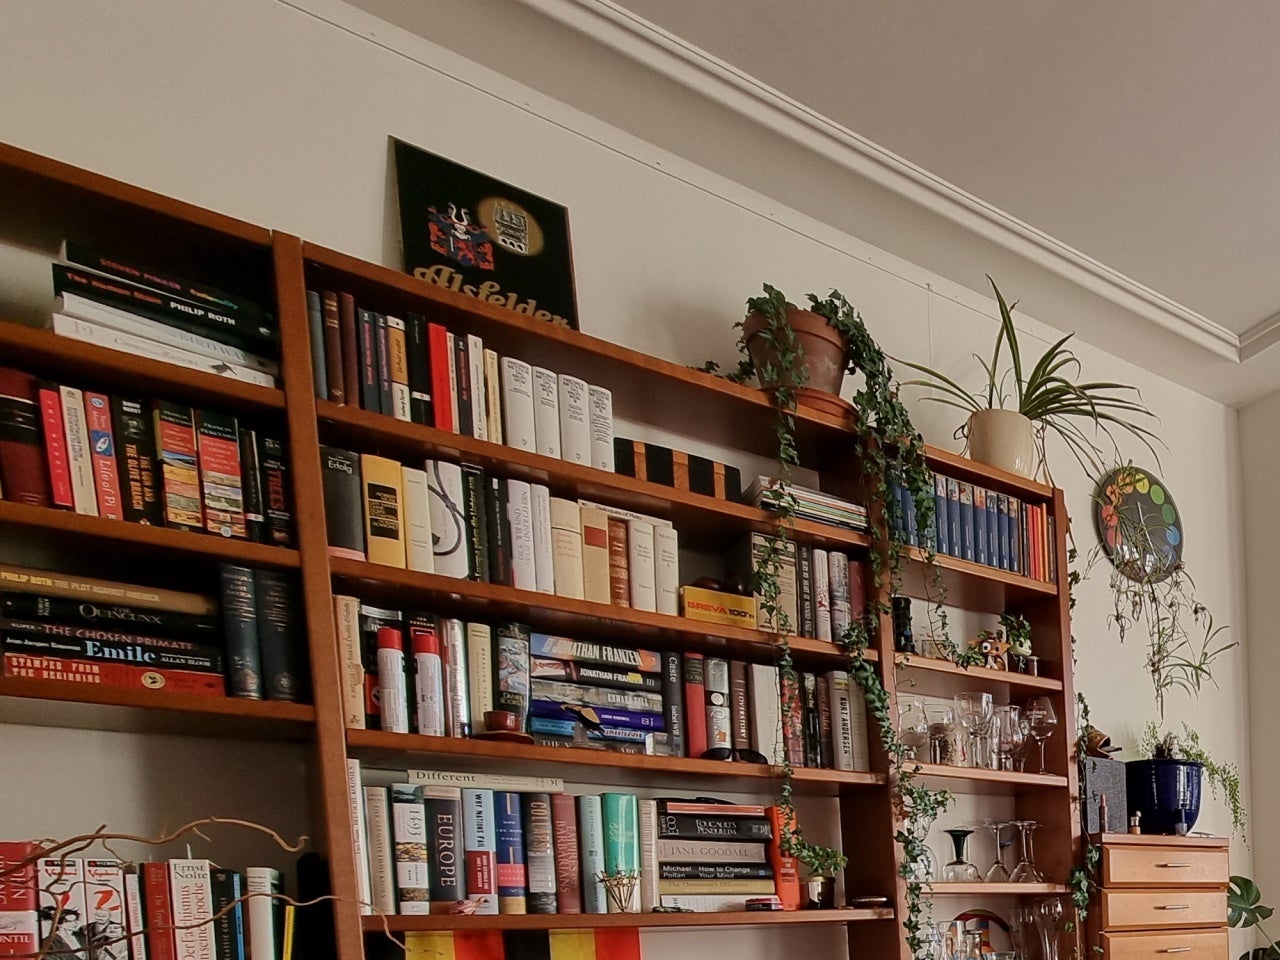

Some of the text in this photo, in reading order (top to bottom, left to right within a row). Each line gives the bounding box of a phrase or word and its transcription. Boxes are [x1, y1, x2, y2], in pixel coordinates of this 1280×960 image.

[170, 301, 236, 326] PHILIP ROTH
[126, 443, 144, 511] THE OLIVE BRANCH
[328, 459, 353, 475] Erfolg
[99, 459, 117, 507] Life of Pi
[140, 456, 155, 502] THE GUN AND
[1, 571, 29, 582] PHILIP
[71, 581, 91, 592] PLOT
[79, 603, 162, 625] QUINCUNX
[687, 601, 727, 614] BREVA
[43, 624, 71, 636] THE
[76, 629, 132, 644] CHOSEN
[137, 635, 194, 651] PRIMATE
[84, 640, 156, 664] Emile
[160, 656, 186, 665] ALLAN
[551, 640, 643, 666] JONATHAN FRANZEN
[11, 657, 100, 674] STAMPED FROM
[12, 667, 101, 684] THE BEGINNING
[579, 667, 613, 681] JONATHAN
[669, 657, 678, 683] Caste
[737, 694, 746, 739] OVERSTORY
[839, 697, 850, 755] KURT ANDERSEN
[416, 771, 476, 783] Different
[406, 809, 422, 837] 1493
[474, 794, 486, 848] WHY NATIONS FAIL
[667, 815, 679, 835] ECO
[696, 819, 737, 828] FOUCAULT'S
[697, 826, 737, 835] PENDULUM
[437, 814, 456, 887] EUROPE
[556, 820, 570, 893] BARBARIANS
[565, 825, 579, 872] EMPIRES
[671, 847, 751, 857] JANE GOODALL
[174, 862, 206, 872] Ernst
[174, 871, 208, 879] Nolte
[663, 871, 686, 879] Pollan
[725, 867, 751, 875] Change
[192, 882, 208, 921] Epoche
[131, 902, 139, 927] TYRANNY
[179, 885, 194, 942] Fahismus
[0, 935, 31, 943] NTIL
[198, 926, 209, 952] seine
[221, 937, 231, 960] CLASSIC
